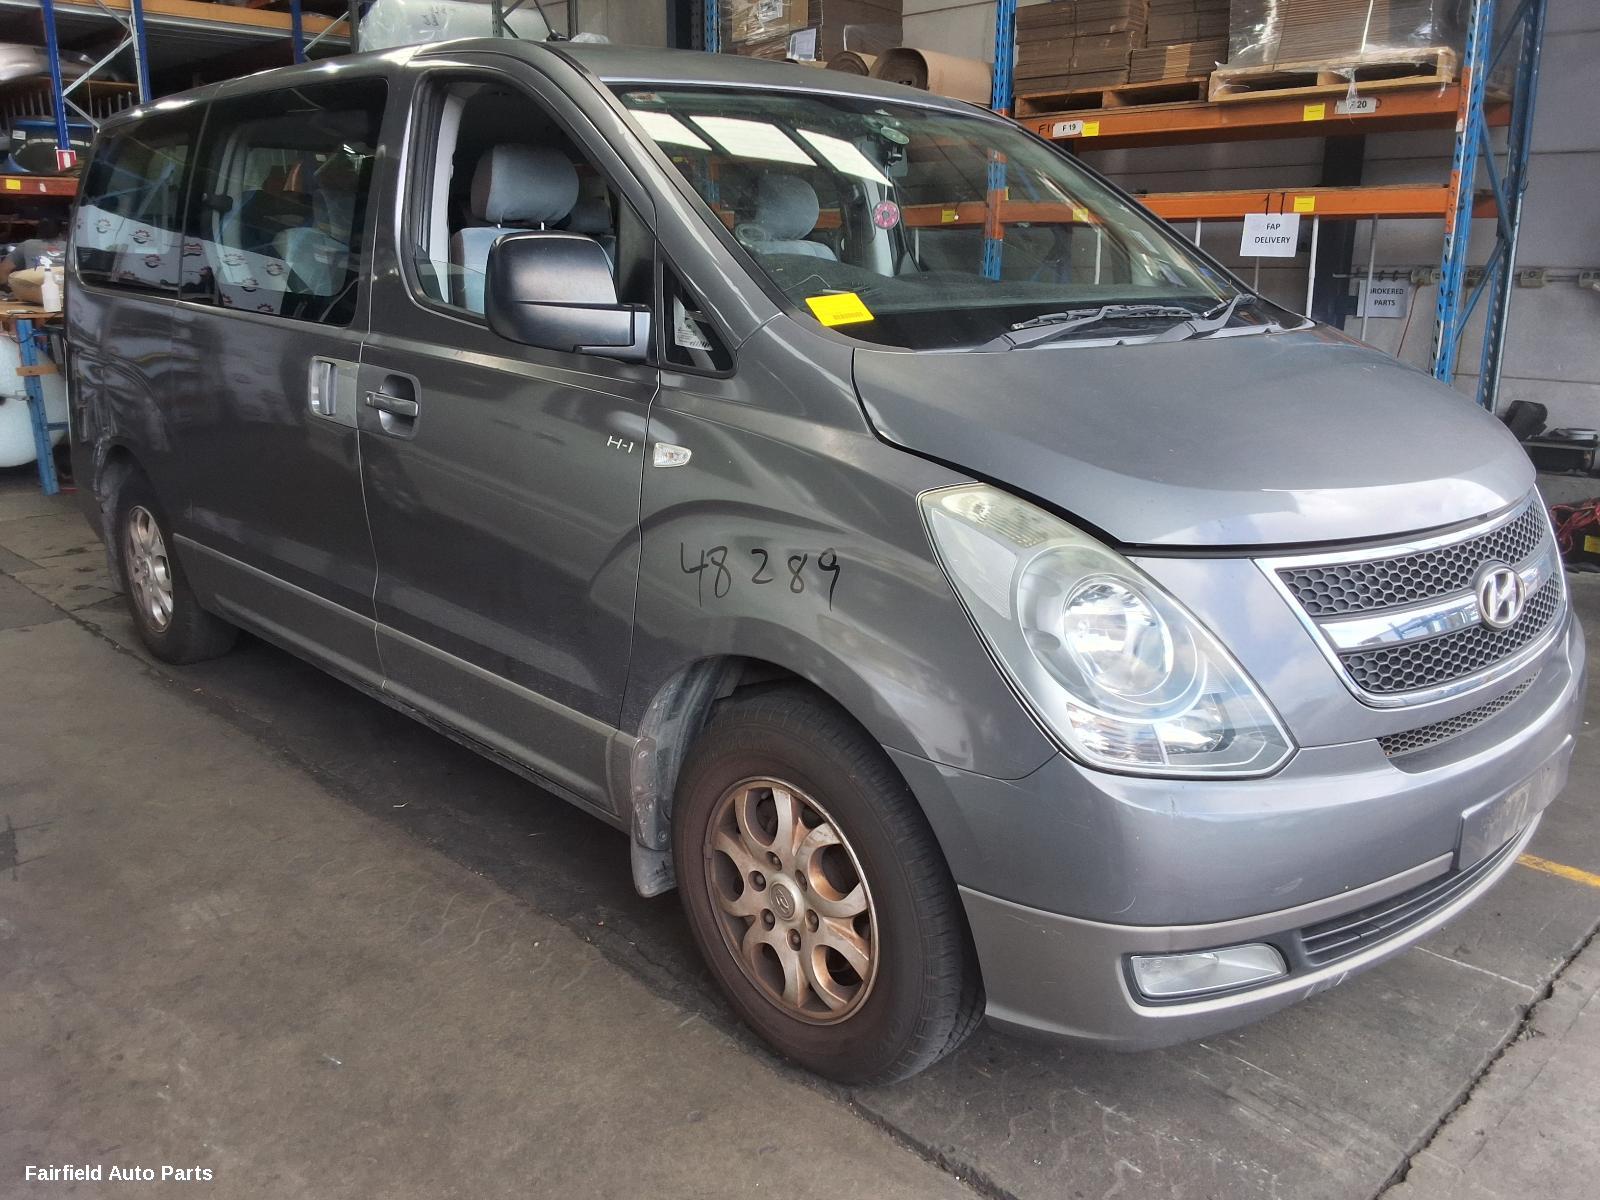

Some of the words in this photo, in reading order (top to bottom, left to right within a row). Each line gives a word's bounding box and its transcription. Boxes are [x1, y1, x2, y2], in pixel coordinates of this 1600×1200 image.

[1356, 100, 1368, 109] 20
[1062, 124, 1067, 132] F
[1069, 123, 1077, 131] 19
[1266, 223, 1281, 231] FAP
[1254, 236, 1291, 244] DELIVERY
